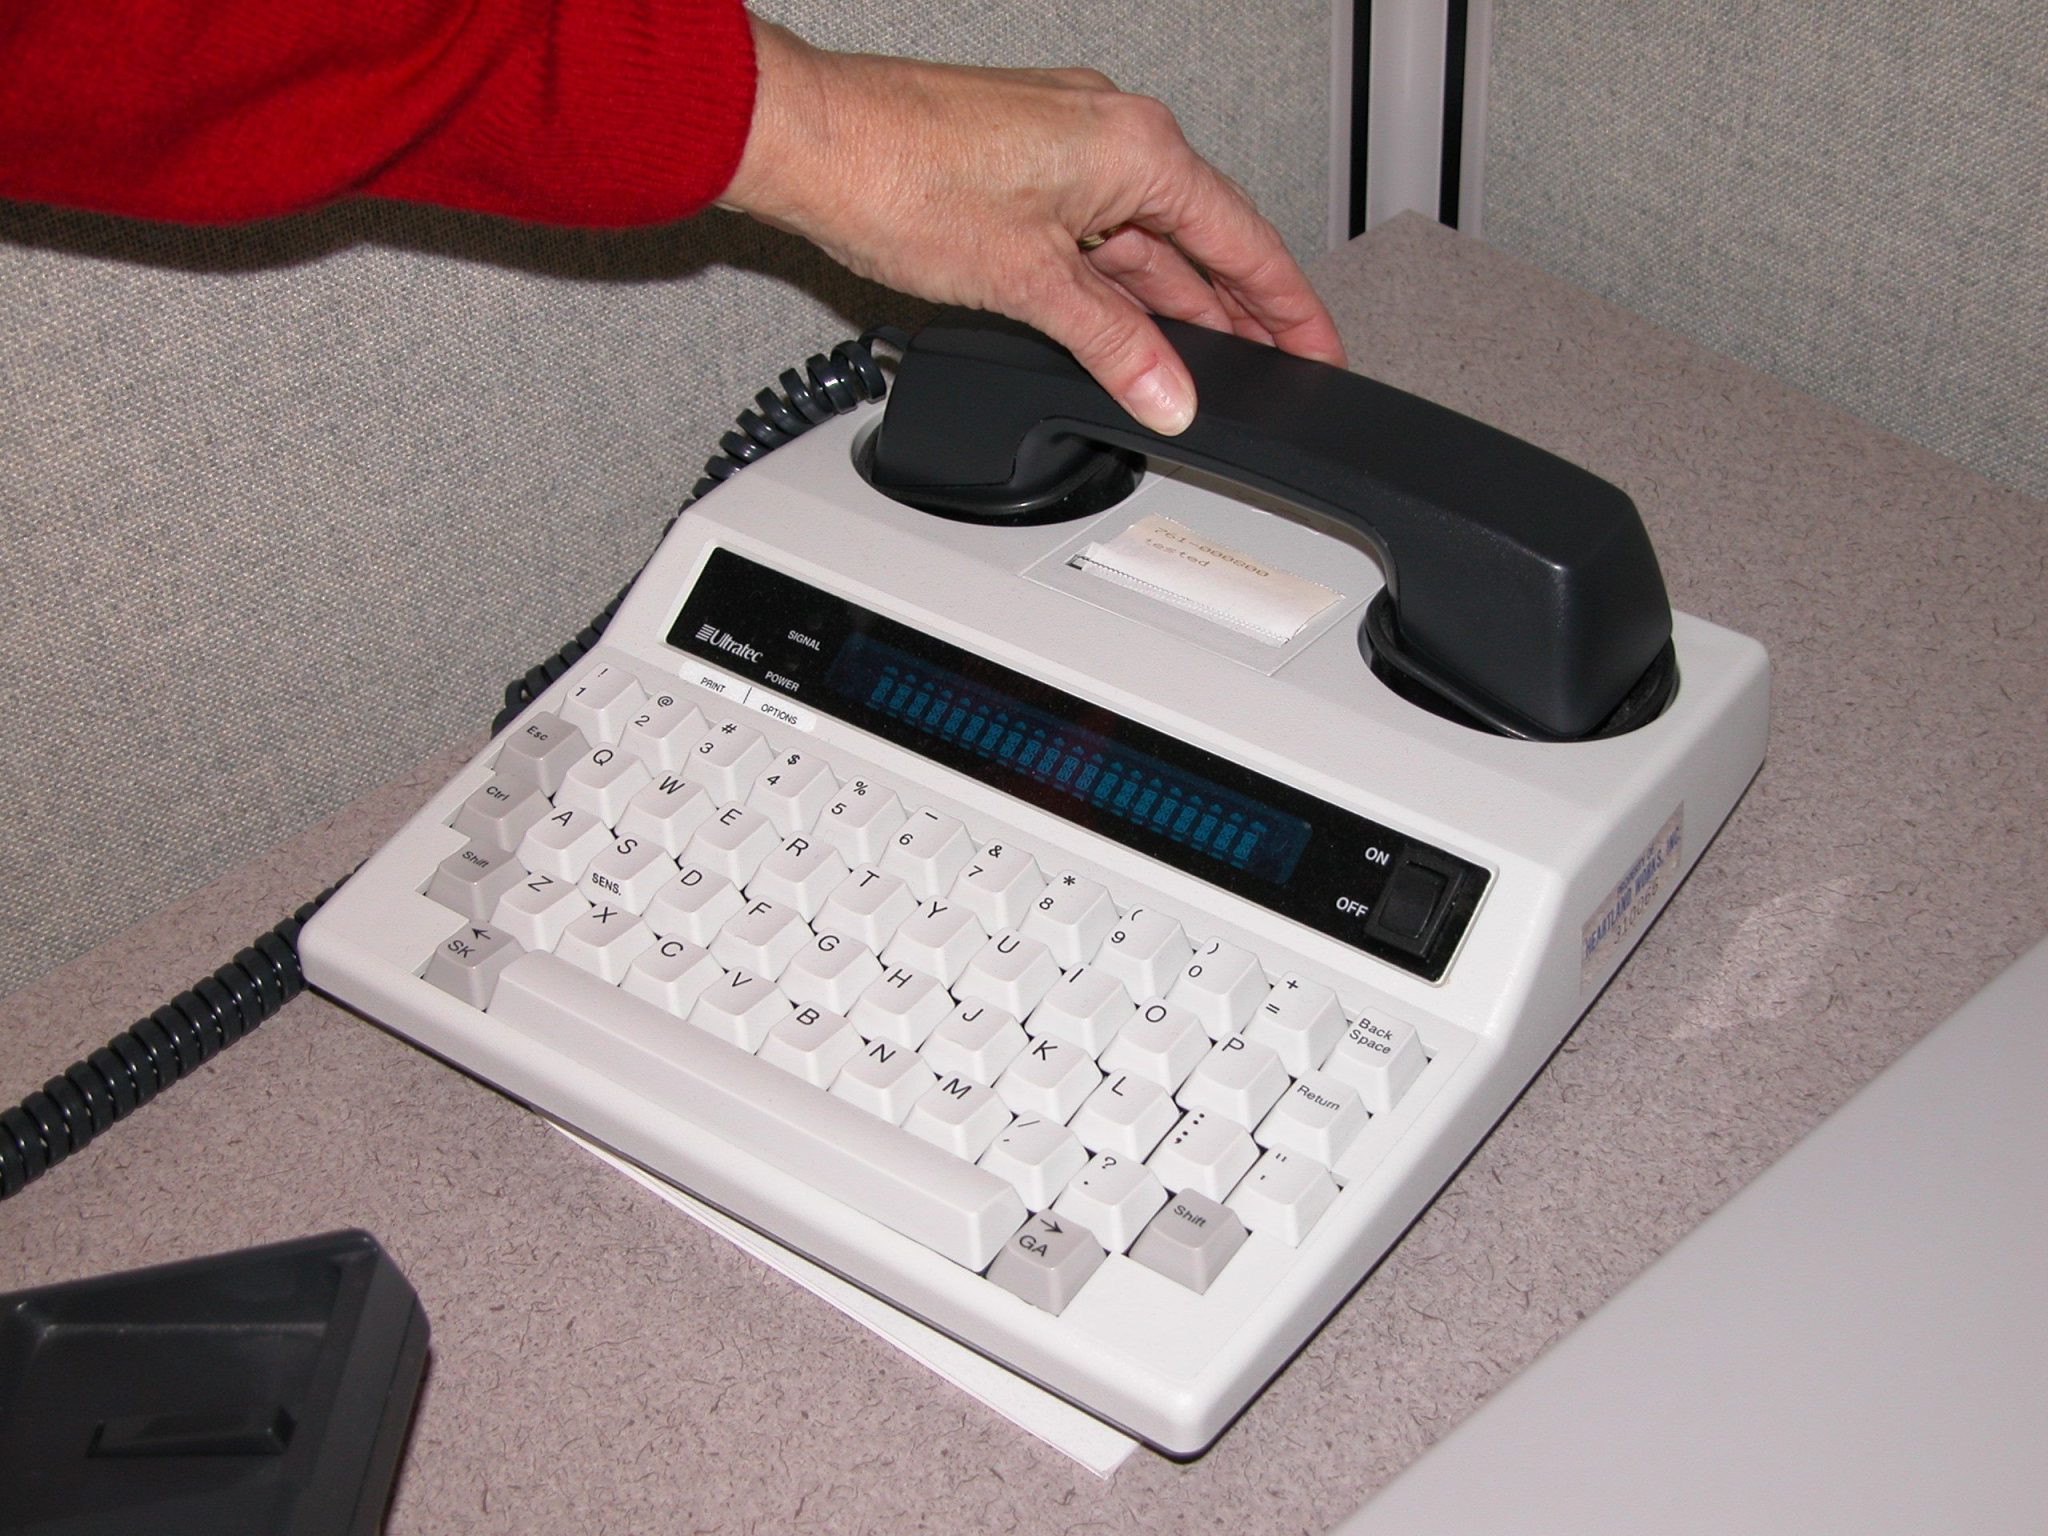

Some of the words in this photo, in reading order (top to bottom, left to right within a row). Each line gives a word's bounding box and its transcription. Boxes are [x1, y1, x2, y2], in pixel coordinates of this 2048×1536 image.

[1145, 538, 1210, 567] tested
[709, 628, 764, 664] Ultratec
[787, 630, 820, 651] SIGNAL
[700, 676, 726, 693] PRINT
[764, 670, 801, 693] POWER
[575, 687, 586, 697] 1
[657, 695, 674, 708] @
[634, 715, 650, 727] 2
[760, 703, 798, 725] OPTIONS
[526, 725, 548, 741] Esc
[721, 723, 737, 734] #
[699, 742, 714, 754] 3
[592, 749, 614, 767] Q
[787, 754, 801, 765] $
[659, 775, 685, 795] W
[767, 775, 781, 786] 4
[853, 780, 868, 796] %
[486, 786, 510, 801] Ctrl
[719, 808, 743, 826] E
[831, 802, 847, 815] 5
[551, 811, 573, 827] A
[617, 839, 638, 855] S
[785, 837, 809, 857] R
[899, 833, 914, 846] 6
[462, 851, 489, 868] Shift
[988, 845, 1003, 858] &
[1365, 847, 1390, 866] ON
[680, 869, 703, 886] D
[859, 870, 880, 887] T
[968, 865, 984, 877] 7
[527, 875, 554, 892] Z
[591, 872, 621, 895] SENS.
[748, 901, 772, 915] F
[927, 901, 948, 919] Y
[1039, 897, 1054, 910] 8
[1336, 896, 1369, 917] OFF
[592, 906, 618, 924] X
[818, 935, 840, 952] G
[997, 935, 1020, 954] U
[1111, 931, 1126, 944] 9
[447, 939, 475, 959] SK
[661, 941, 684, 957] C
[731, 971, 753, 988] V
[887, 968, 913, 989] H
[796, 1007, 820, 1026] B
[961, 1008, 984, 1022] J
[1145, 1005, 1167, 1023] O
[1358, 1017, 1393, 1041] Back
[1032, 1040, 1058, 1061] K
[1221, 1037, 1245, 1052] P
[1349, 1029, 1391, 1055] Space
[869, 1043, 896, 1063] N
[942, 1078, 972, 1100] M
[1111, 1076, 1127, 1097] L
[1297, 1084, 1340, 1110] Return
[1101, 1156, 1117, 1170] ?
[1173, 1205, 1207, 1228] Shift
[1019, 1235, 1048, 1257] GA
